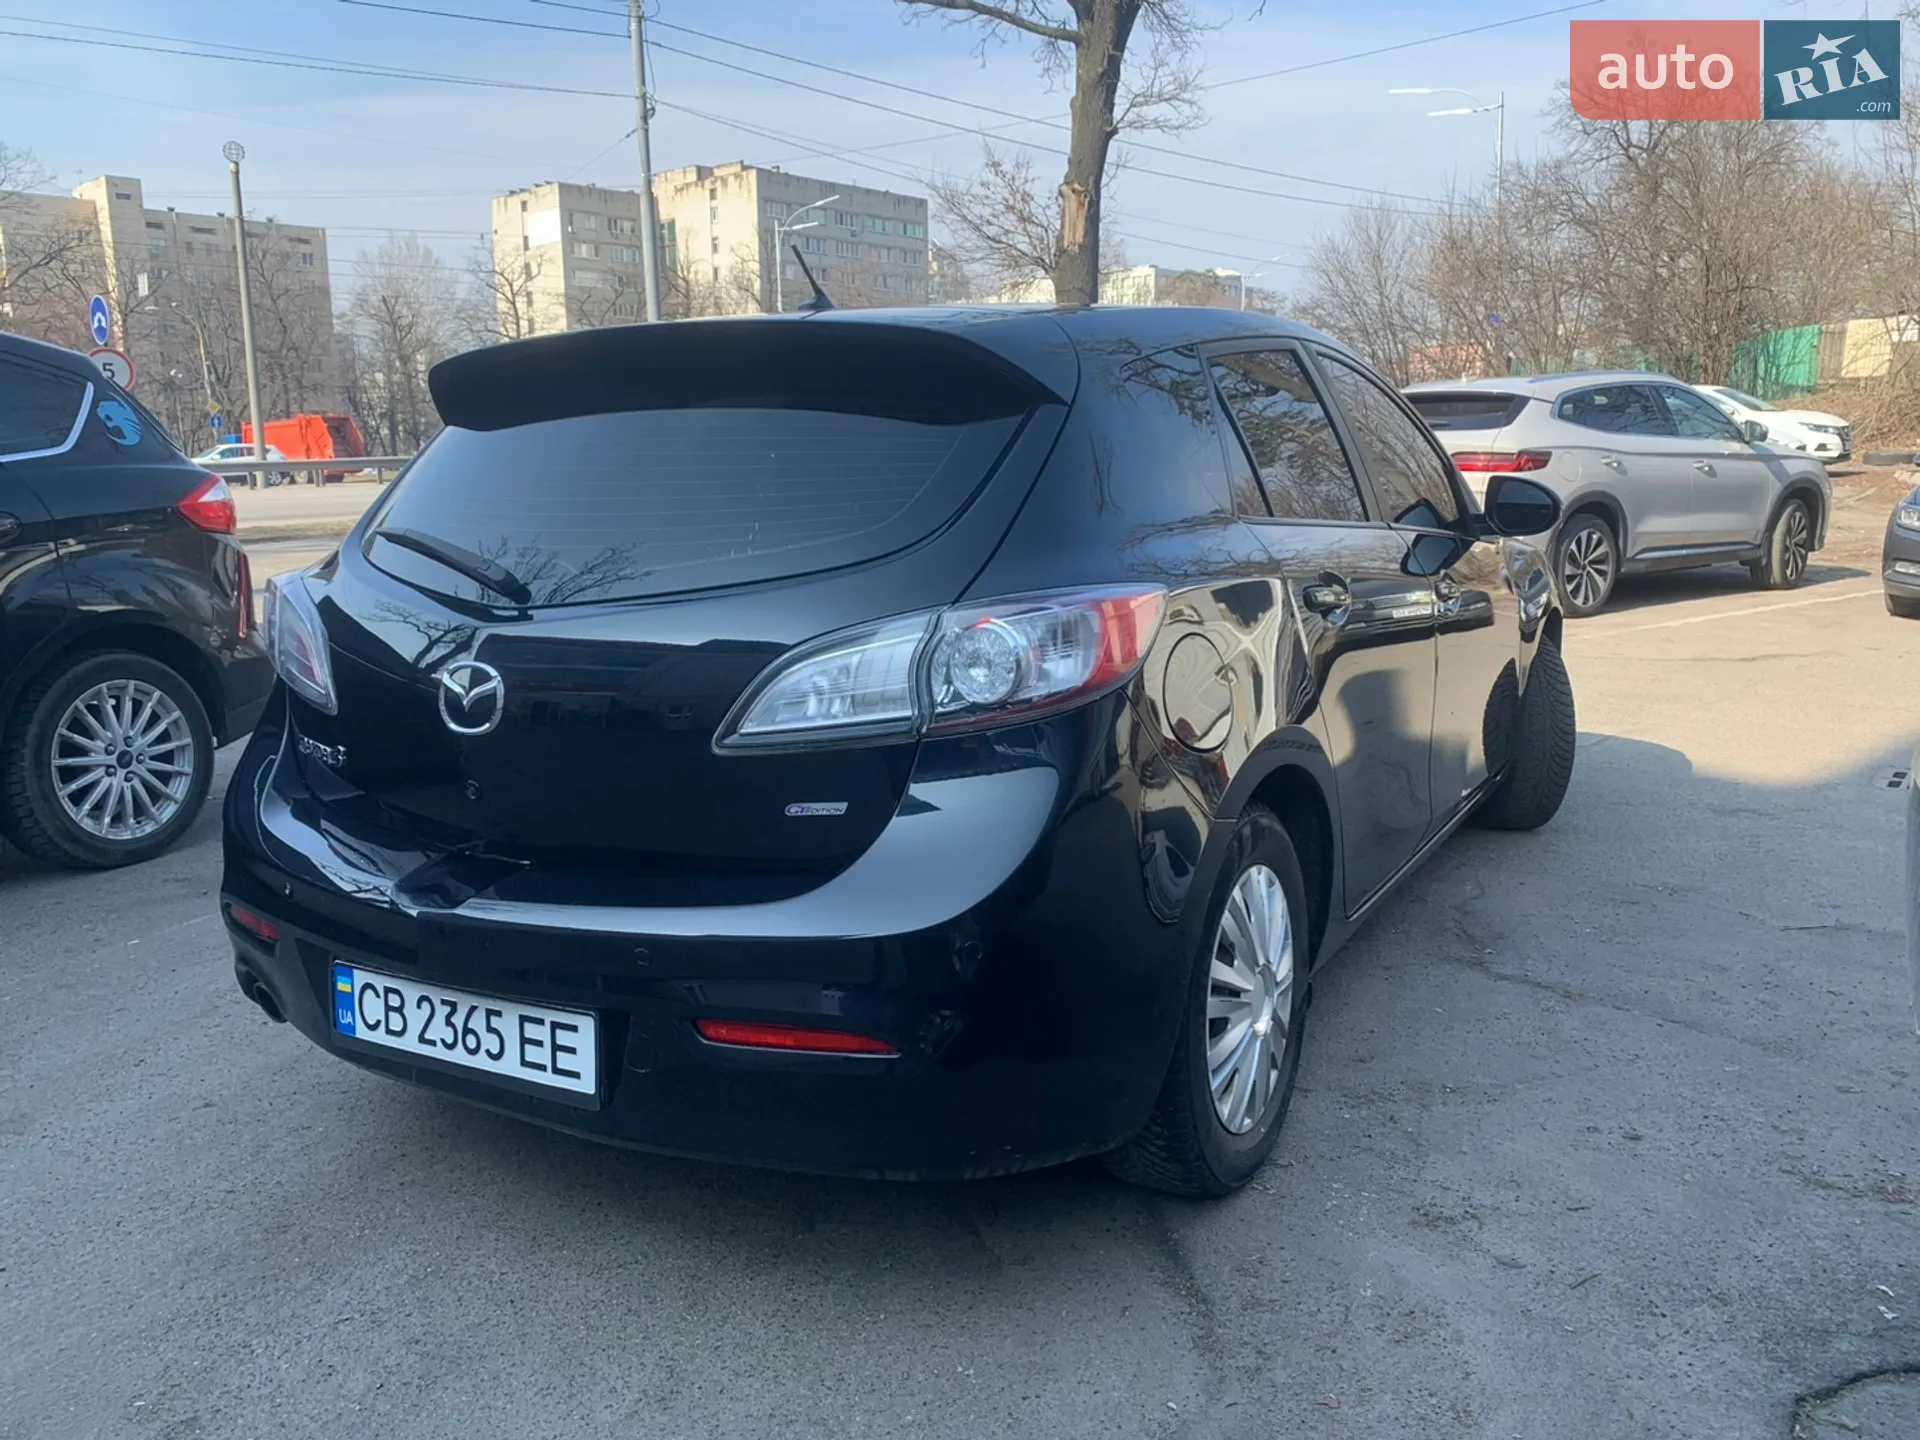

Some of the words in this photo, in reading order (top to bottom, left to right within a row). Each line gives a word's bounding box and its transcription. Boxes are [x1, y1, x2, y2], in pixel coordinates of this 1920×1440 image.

[102, 362, 115, 381] 5
[338, 1008, 354, 1026] UA
[358, 982, 408, 1038] CB
[416, 994, 505, 1062] 2365
[519, 1013, 581, 1080] EE
